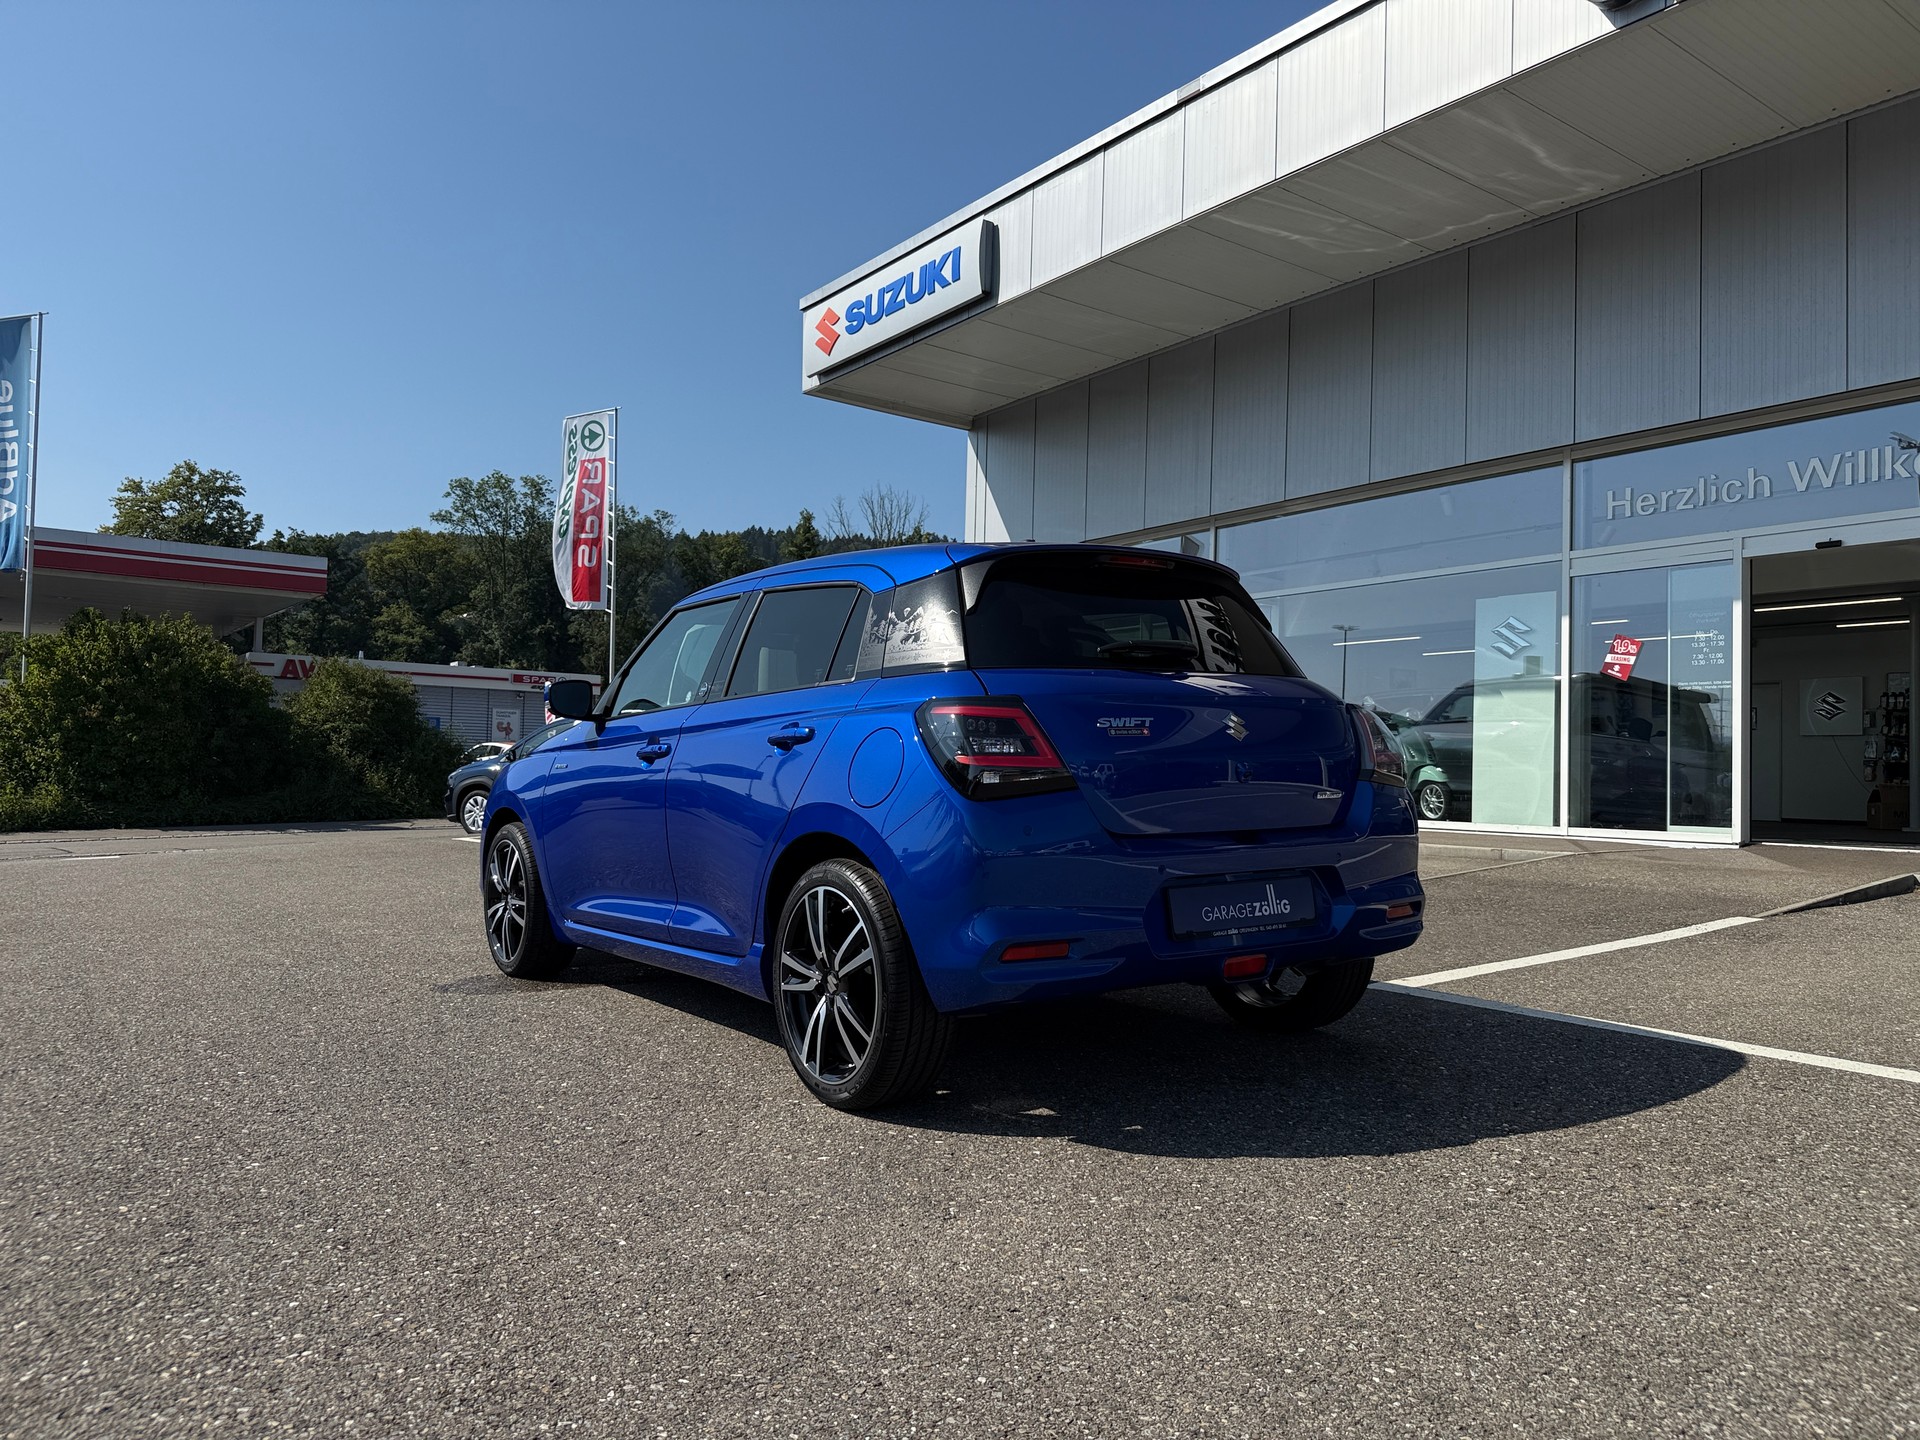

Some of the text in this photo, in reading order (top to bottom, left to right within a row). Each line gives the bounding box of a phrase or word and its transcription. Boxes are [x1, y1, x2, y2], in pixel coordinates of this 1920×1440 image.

[845, 246, 961, 335] SUZUKI
[1606, 445, 1920, 520] Herzlich Willk
[1610, 655, 1631, 663] LEASING
[1096, 717, 1154, 728] SWIFT
